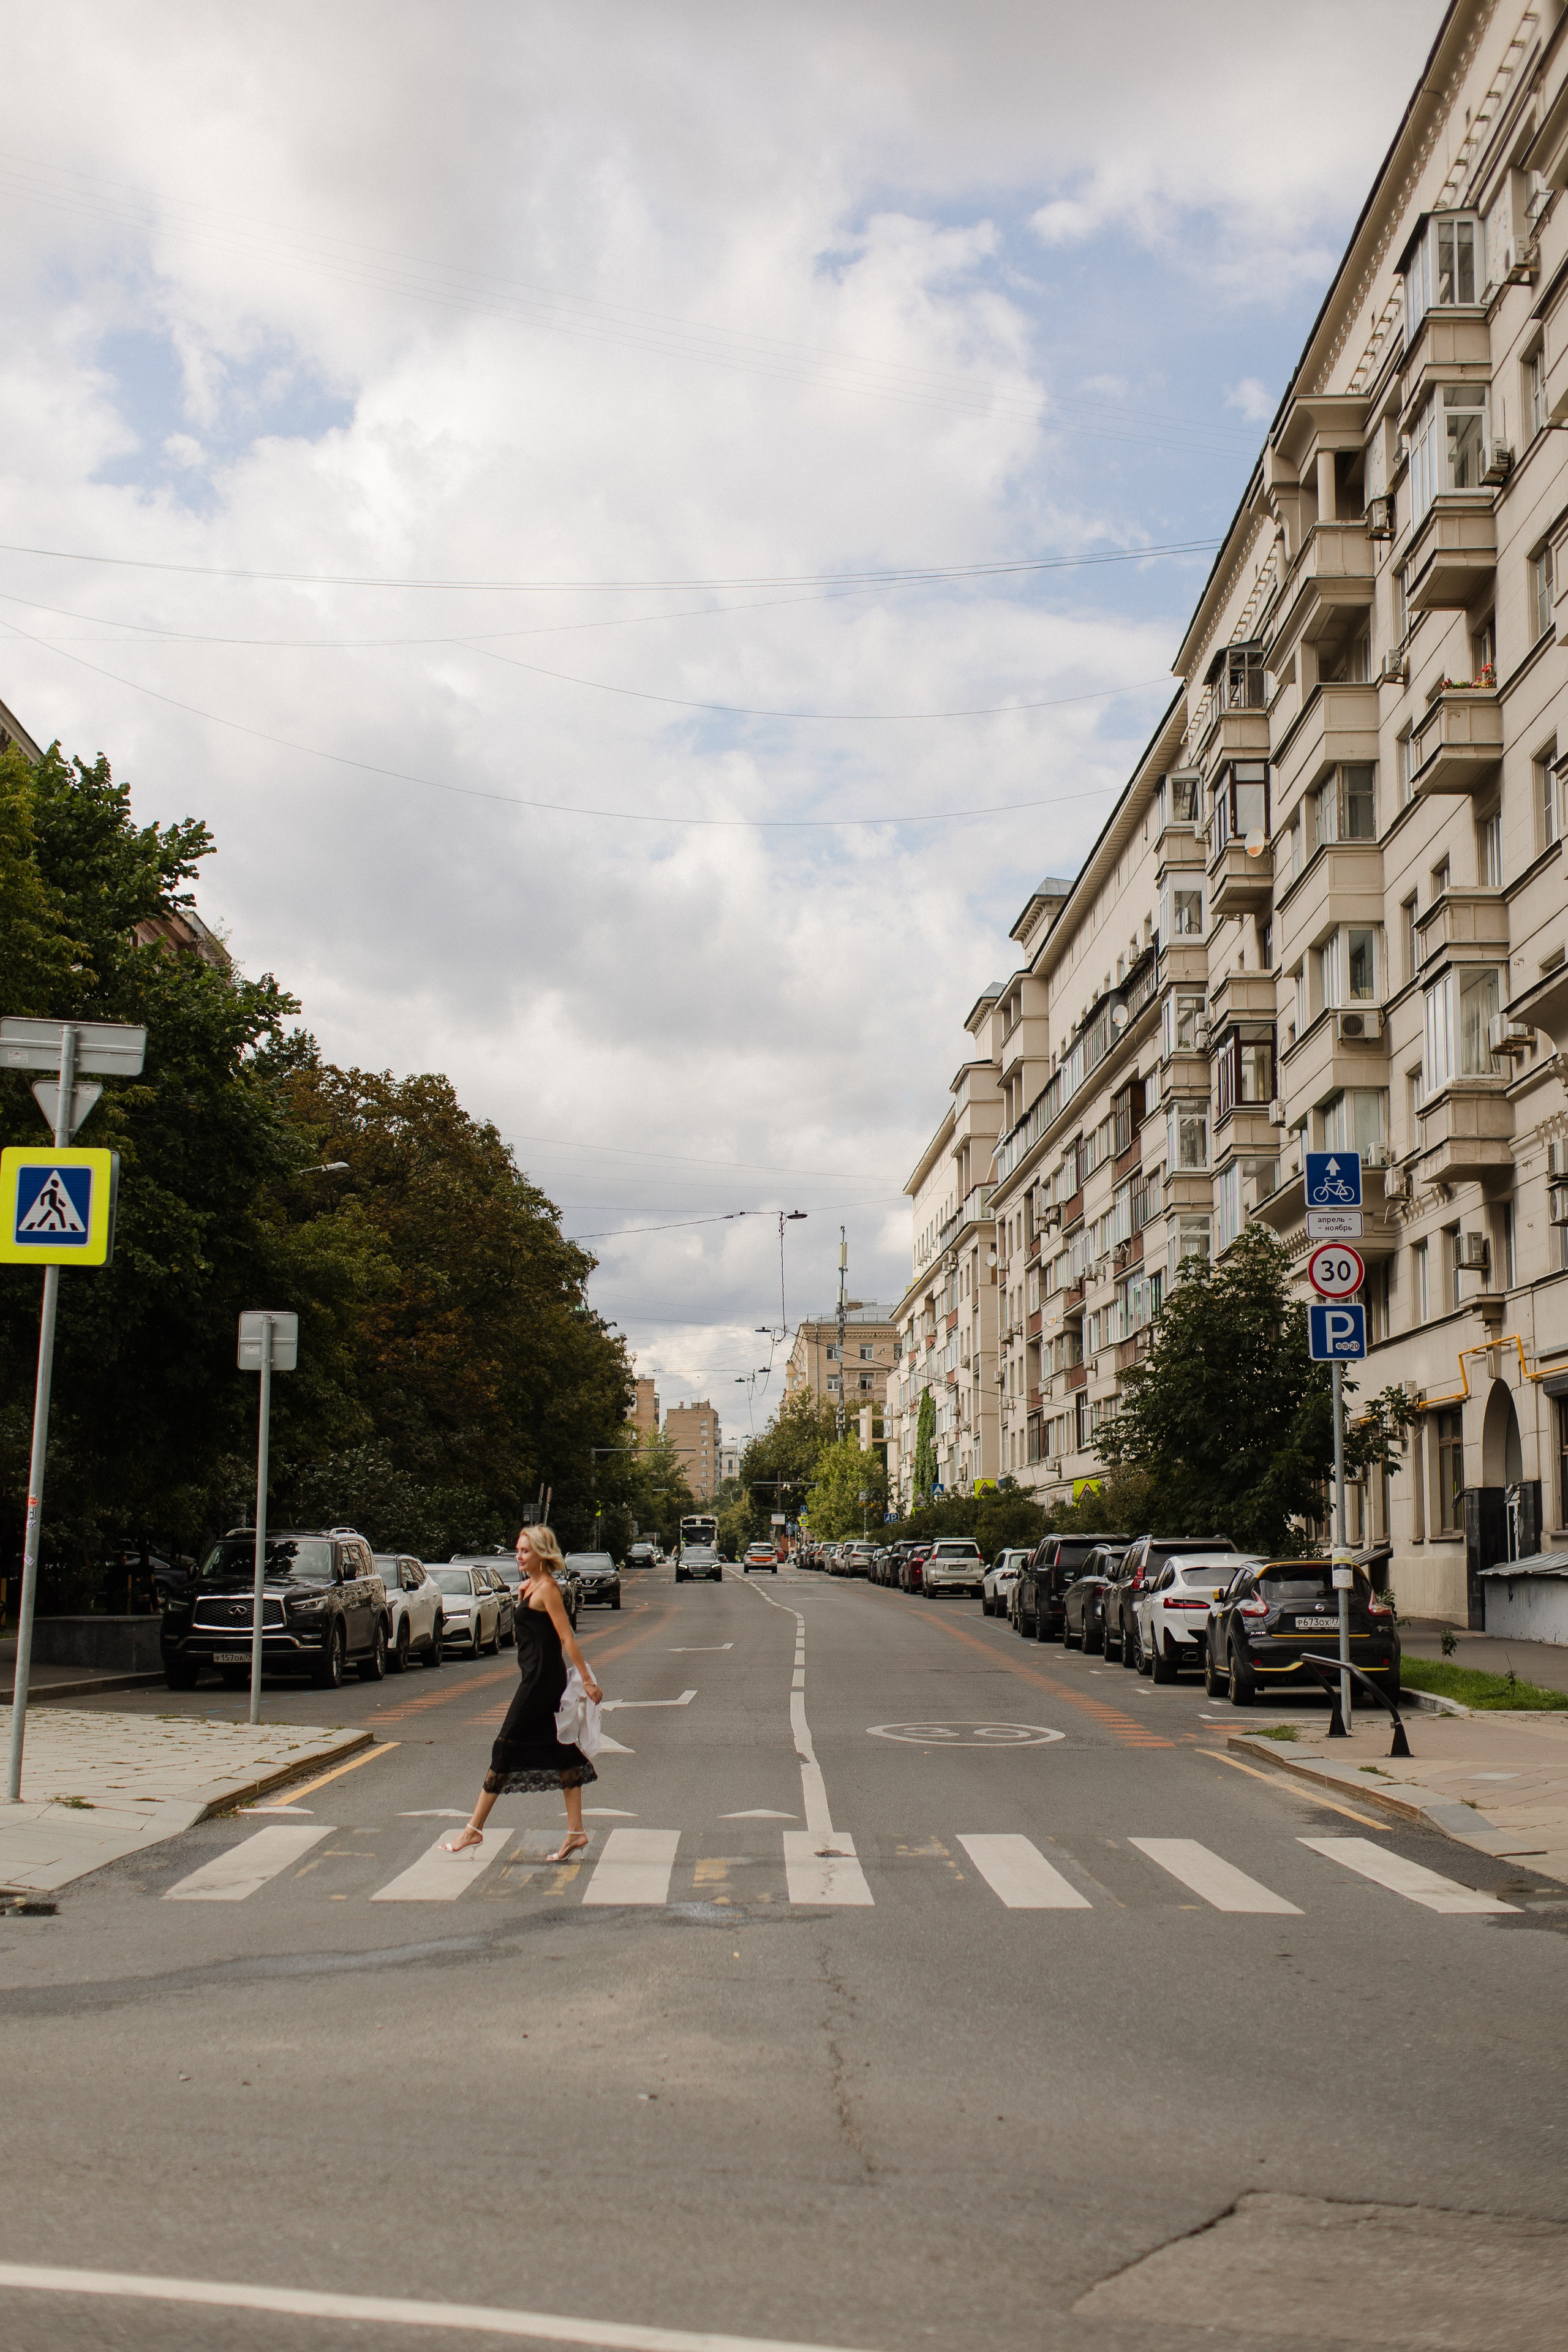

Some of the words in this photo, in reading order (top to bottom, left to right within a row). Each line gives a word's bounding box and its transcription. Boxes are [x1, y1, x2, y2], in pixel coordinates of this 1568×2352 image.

[1321, 1260, 1351, 1281] 30
[1325, 1311, 1354, 1353] P
[903, 1727, 1031, 1738] 30
